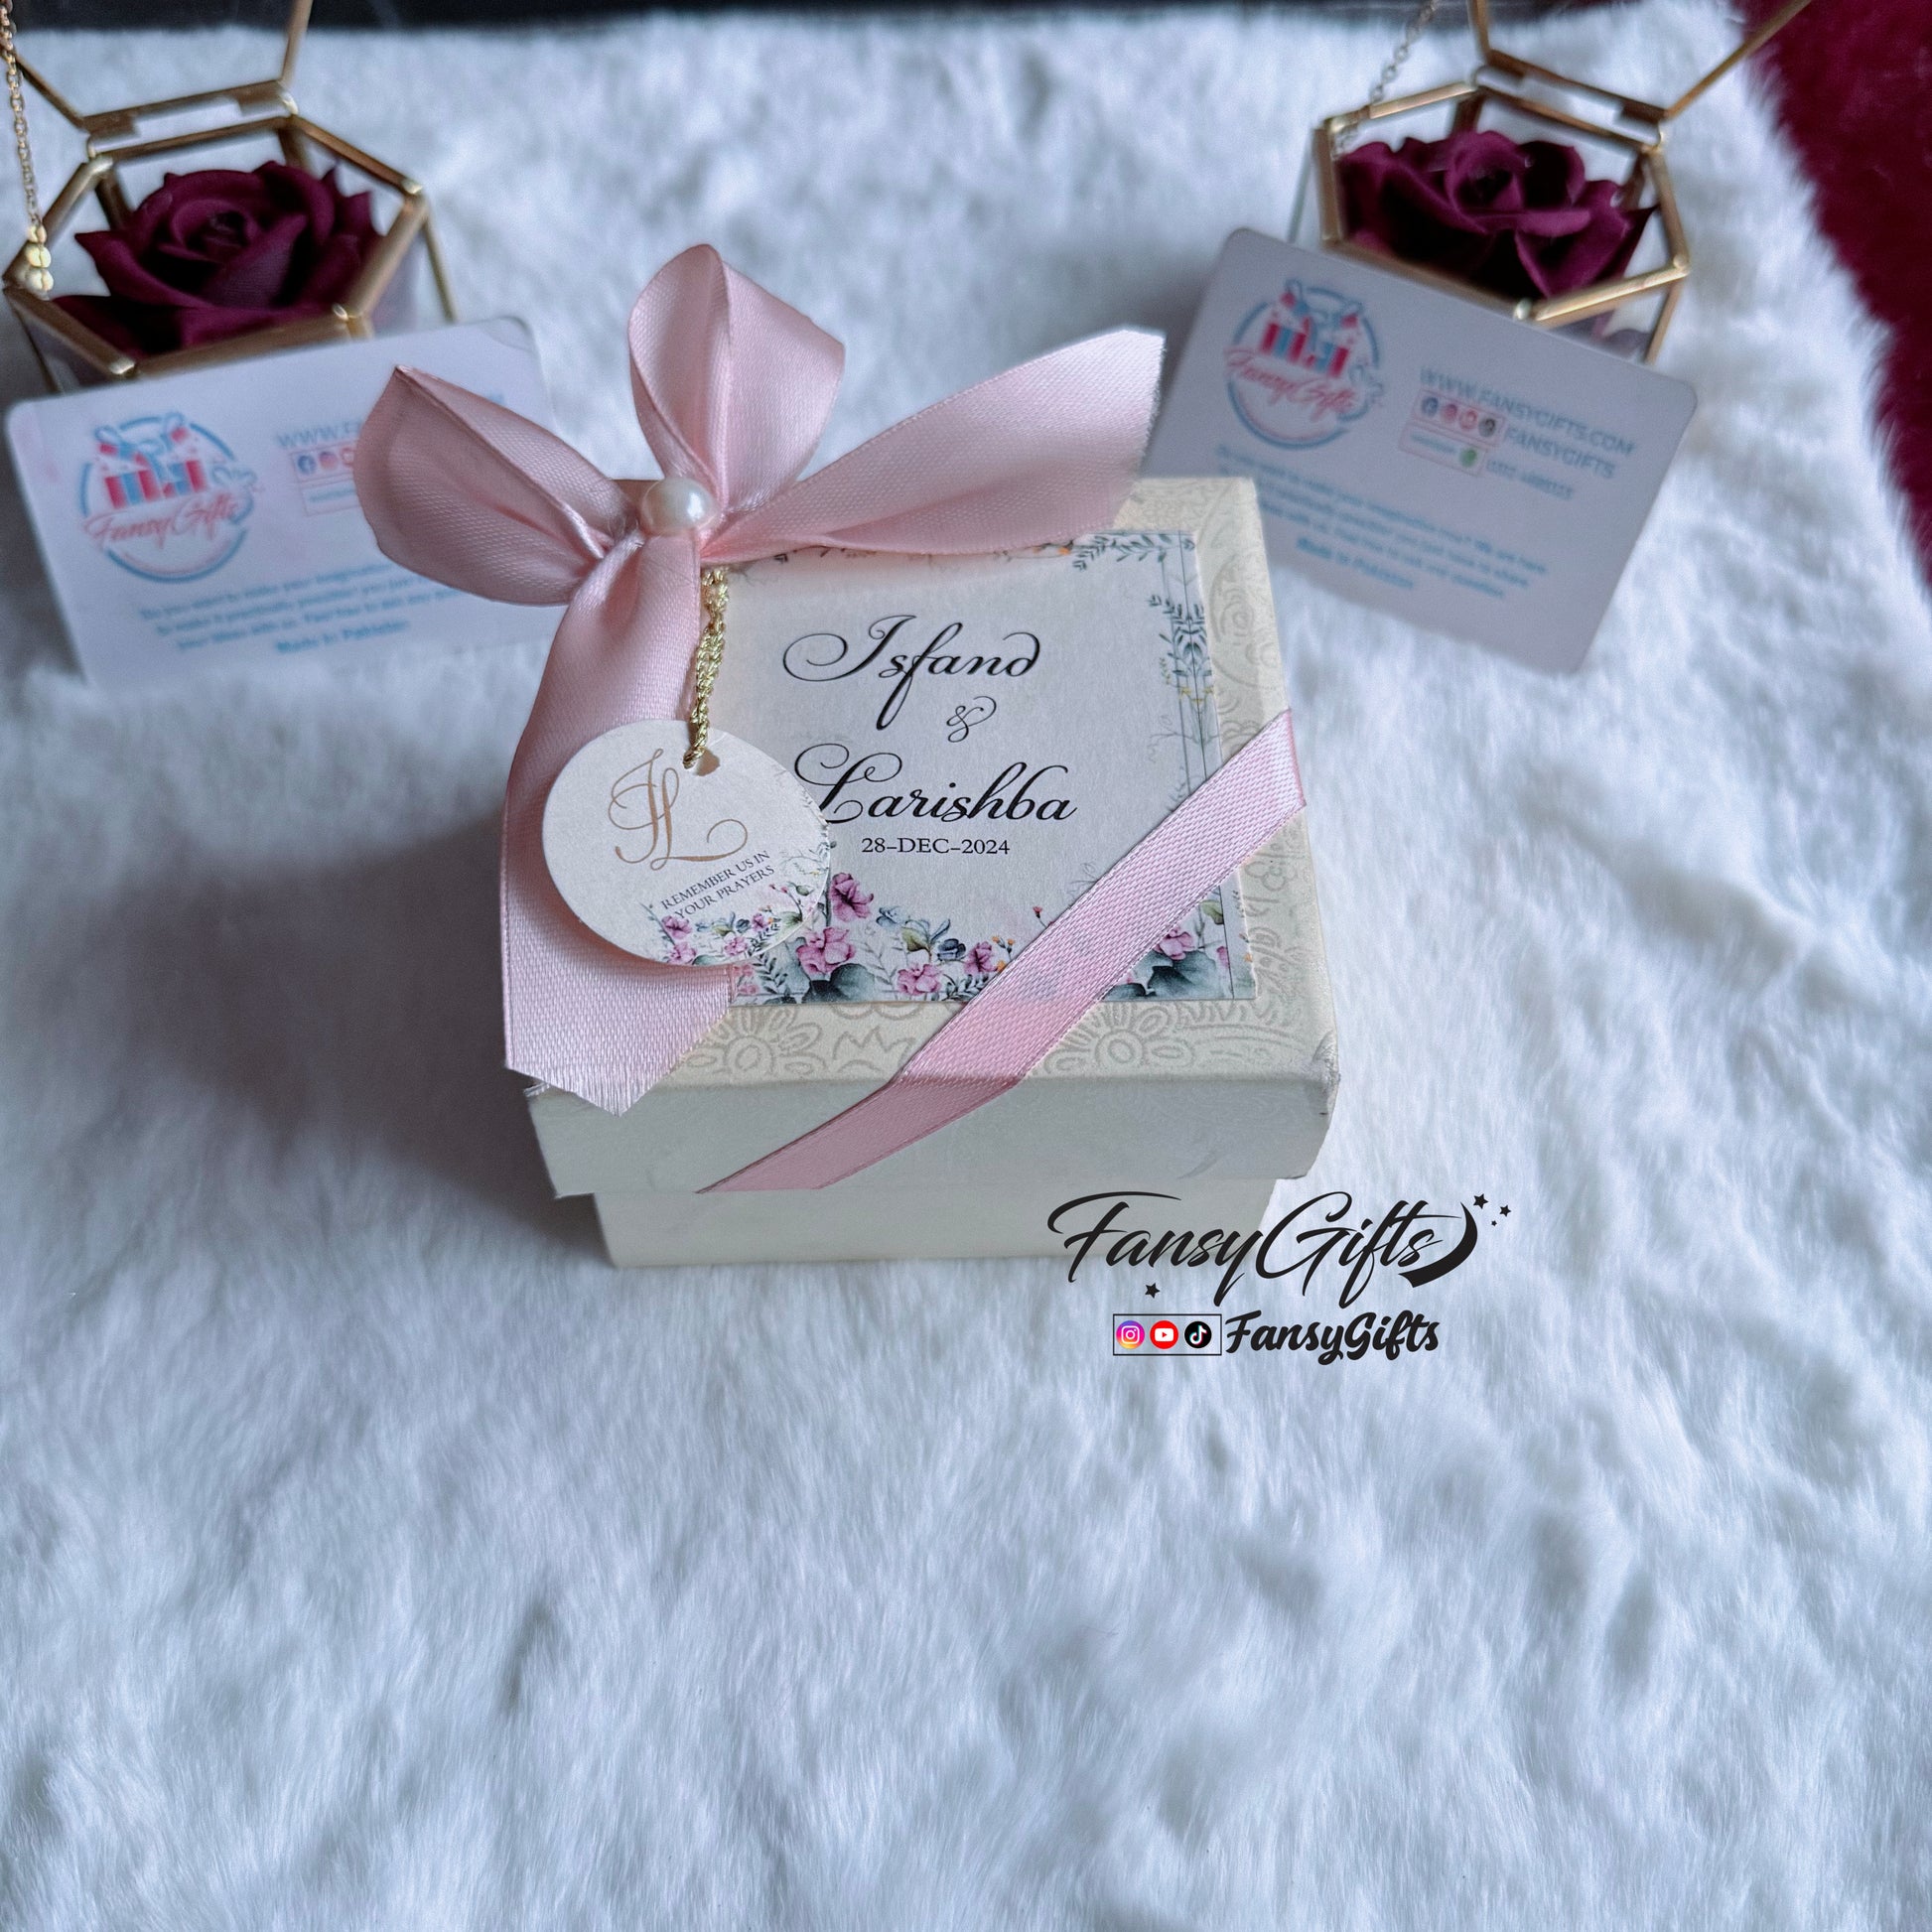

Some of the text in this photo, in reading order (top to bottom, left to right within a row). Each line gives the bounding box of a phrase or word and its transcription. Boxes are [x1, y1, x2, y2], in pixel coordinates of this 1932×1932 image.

[1504, 425, 1616, 480] FANSYGIFTS
[946, 695, 997, 743] &
[794, 743, 1078, 824] Larishba
[661, 850, 770, 909] REMEMBER US IN
[674, 865, 775, 919] YOUR PRAYERS
